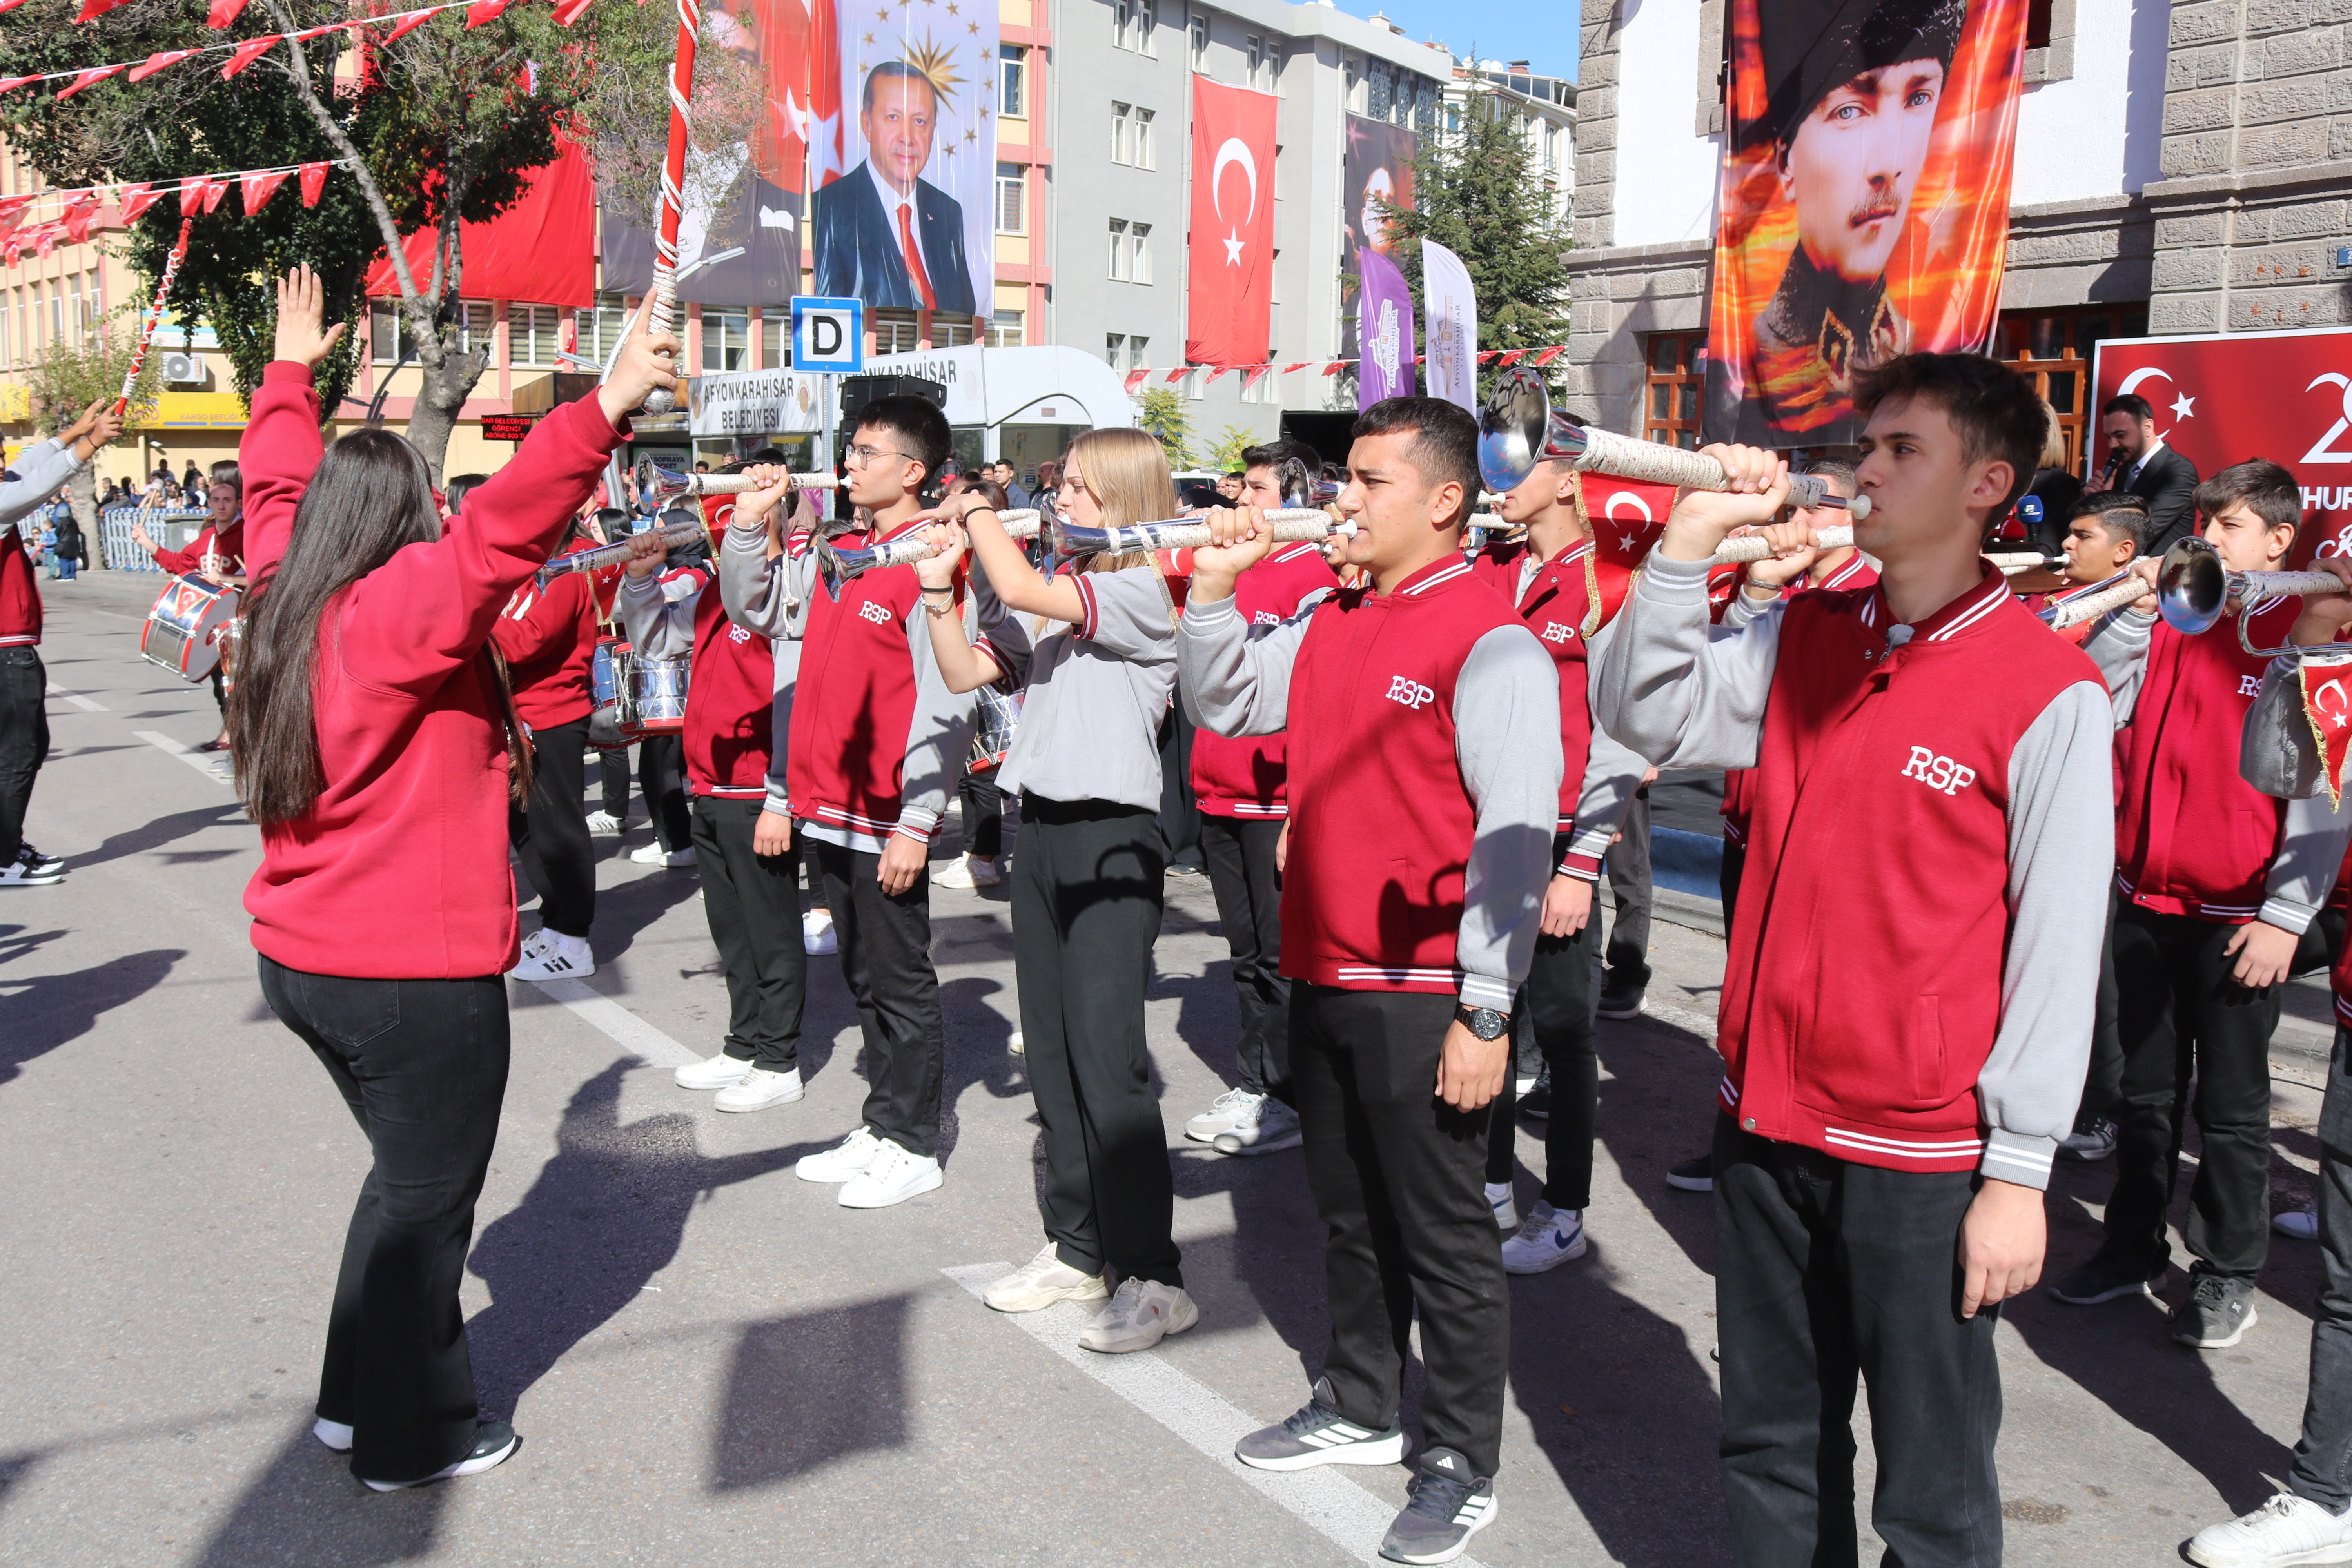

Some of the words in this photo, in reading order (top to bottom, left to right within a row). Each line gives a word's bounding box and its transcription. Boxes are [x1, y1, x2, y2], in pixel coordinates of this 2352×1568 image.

[812, 316, 842, 354] D
[704, 373, 794, 403] AFYONKARAHİSAR
[722, 402, 779, 429] BELEDİYESİ
[2298, 486, 2352, 510] HUR
[858, 600, 892, 625] RSP
[728, 623, 751, 644] RSP
[1385, 675, 1435, 710] RSP
[1901, 746, 1976, 796] RSP
